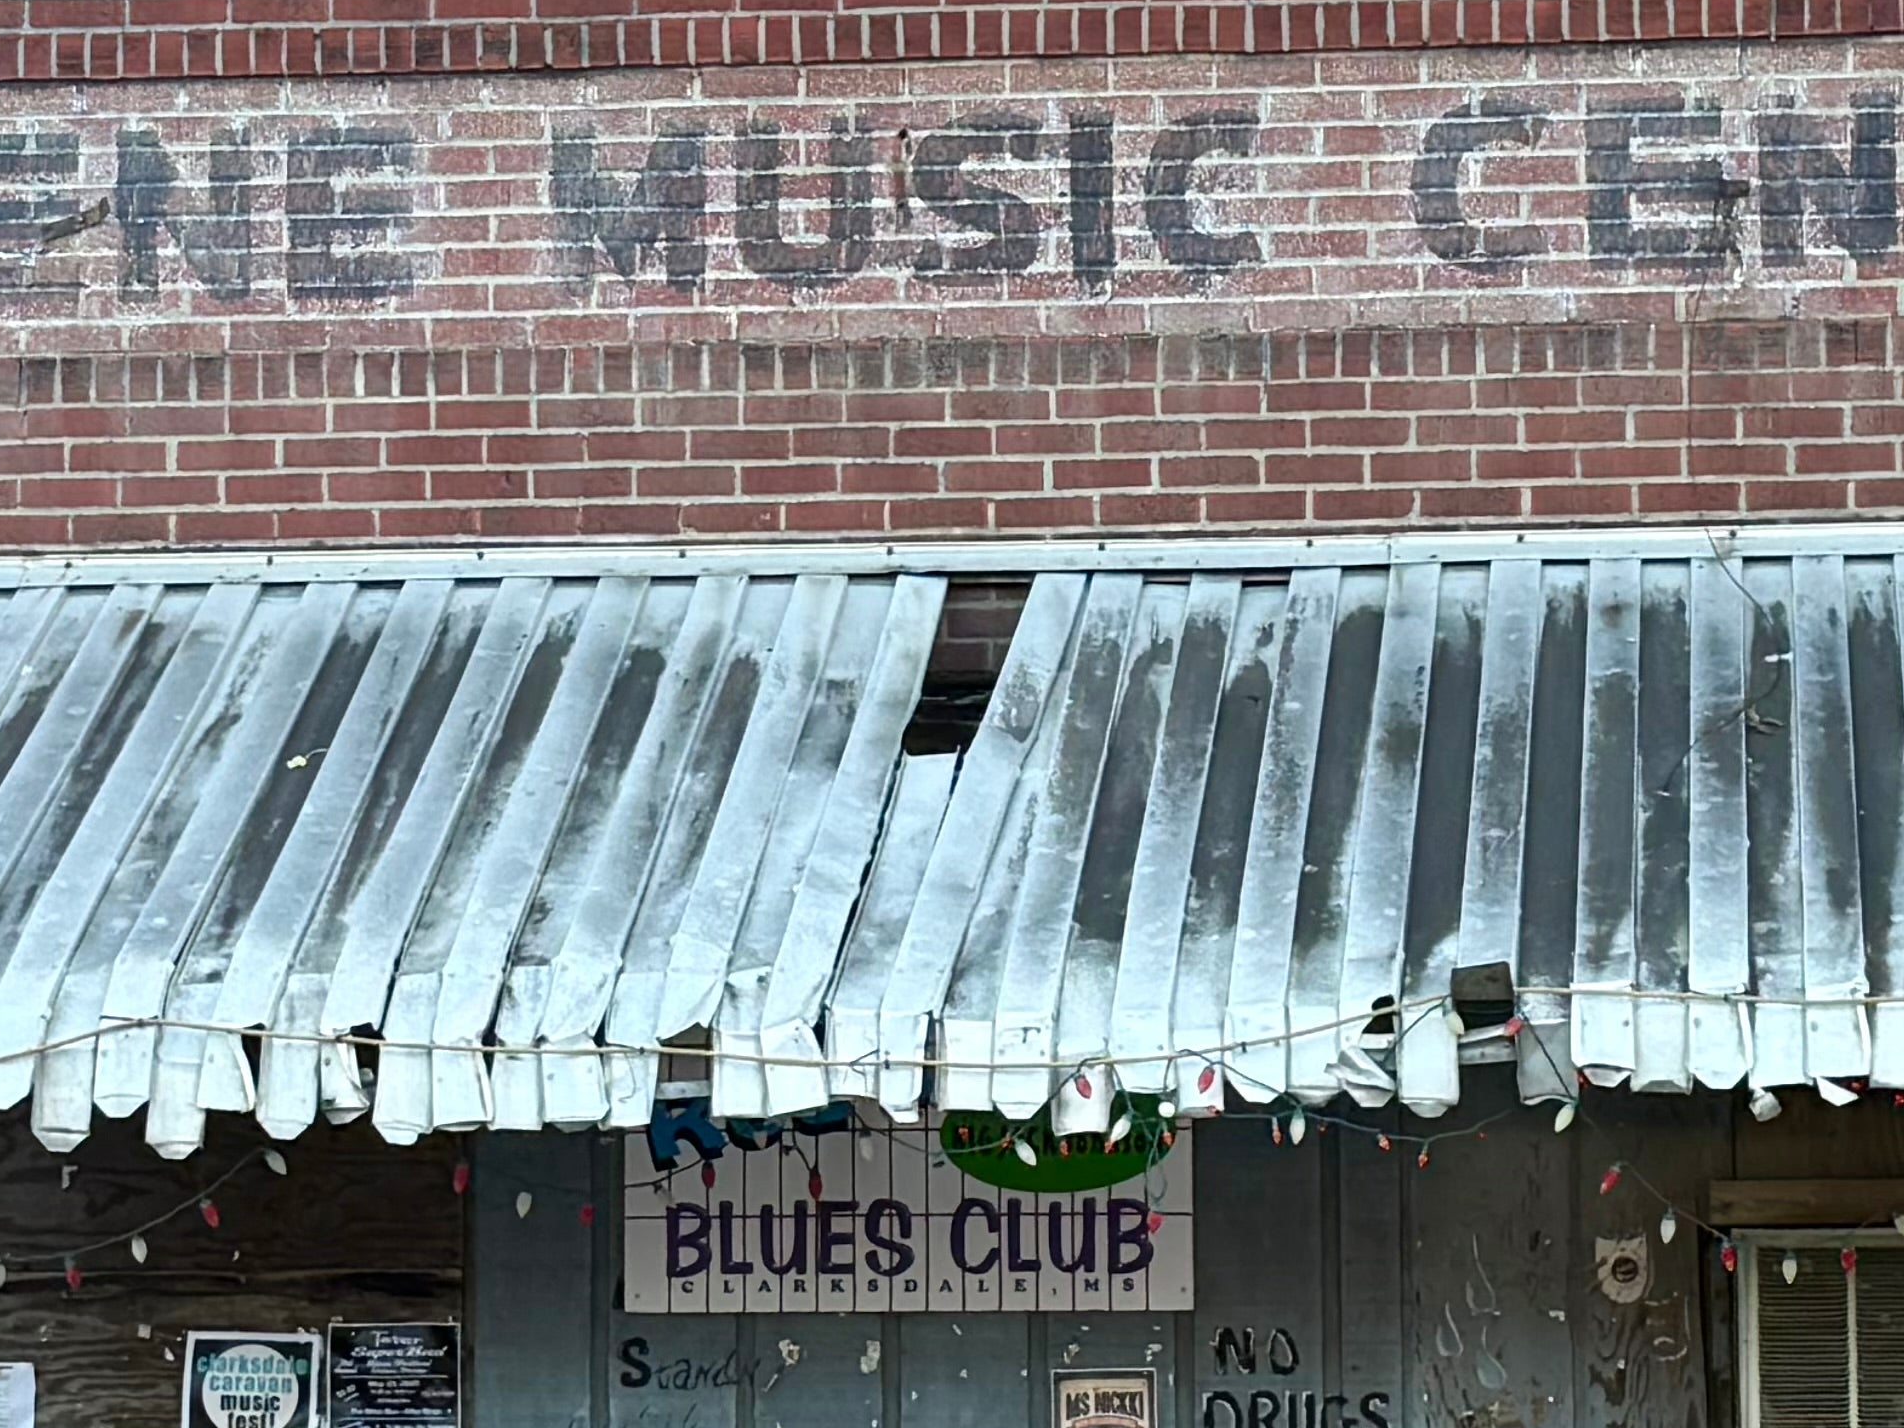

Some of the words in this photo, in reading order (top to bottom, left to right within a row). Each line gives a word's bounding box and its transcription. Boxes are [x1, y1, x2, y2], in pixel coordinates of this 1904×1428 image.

[549, 104, 1264, 294] MUSIC
[665, 1198, 916, 1278] BLUES
[949, 1196, 1154, 1274] CLUB
[680, 1277, 1058, 1296] CLARKSDALE,
[1083, 1278, 1135, 1293] MS
[1210, 1327, 1300, 1375] NO
[196, 1353, 310, 1376] clarksdale
[208, 1373, 293, 1393] caravan
[220, 1393, 281, 1412] music
